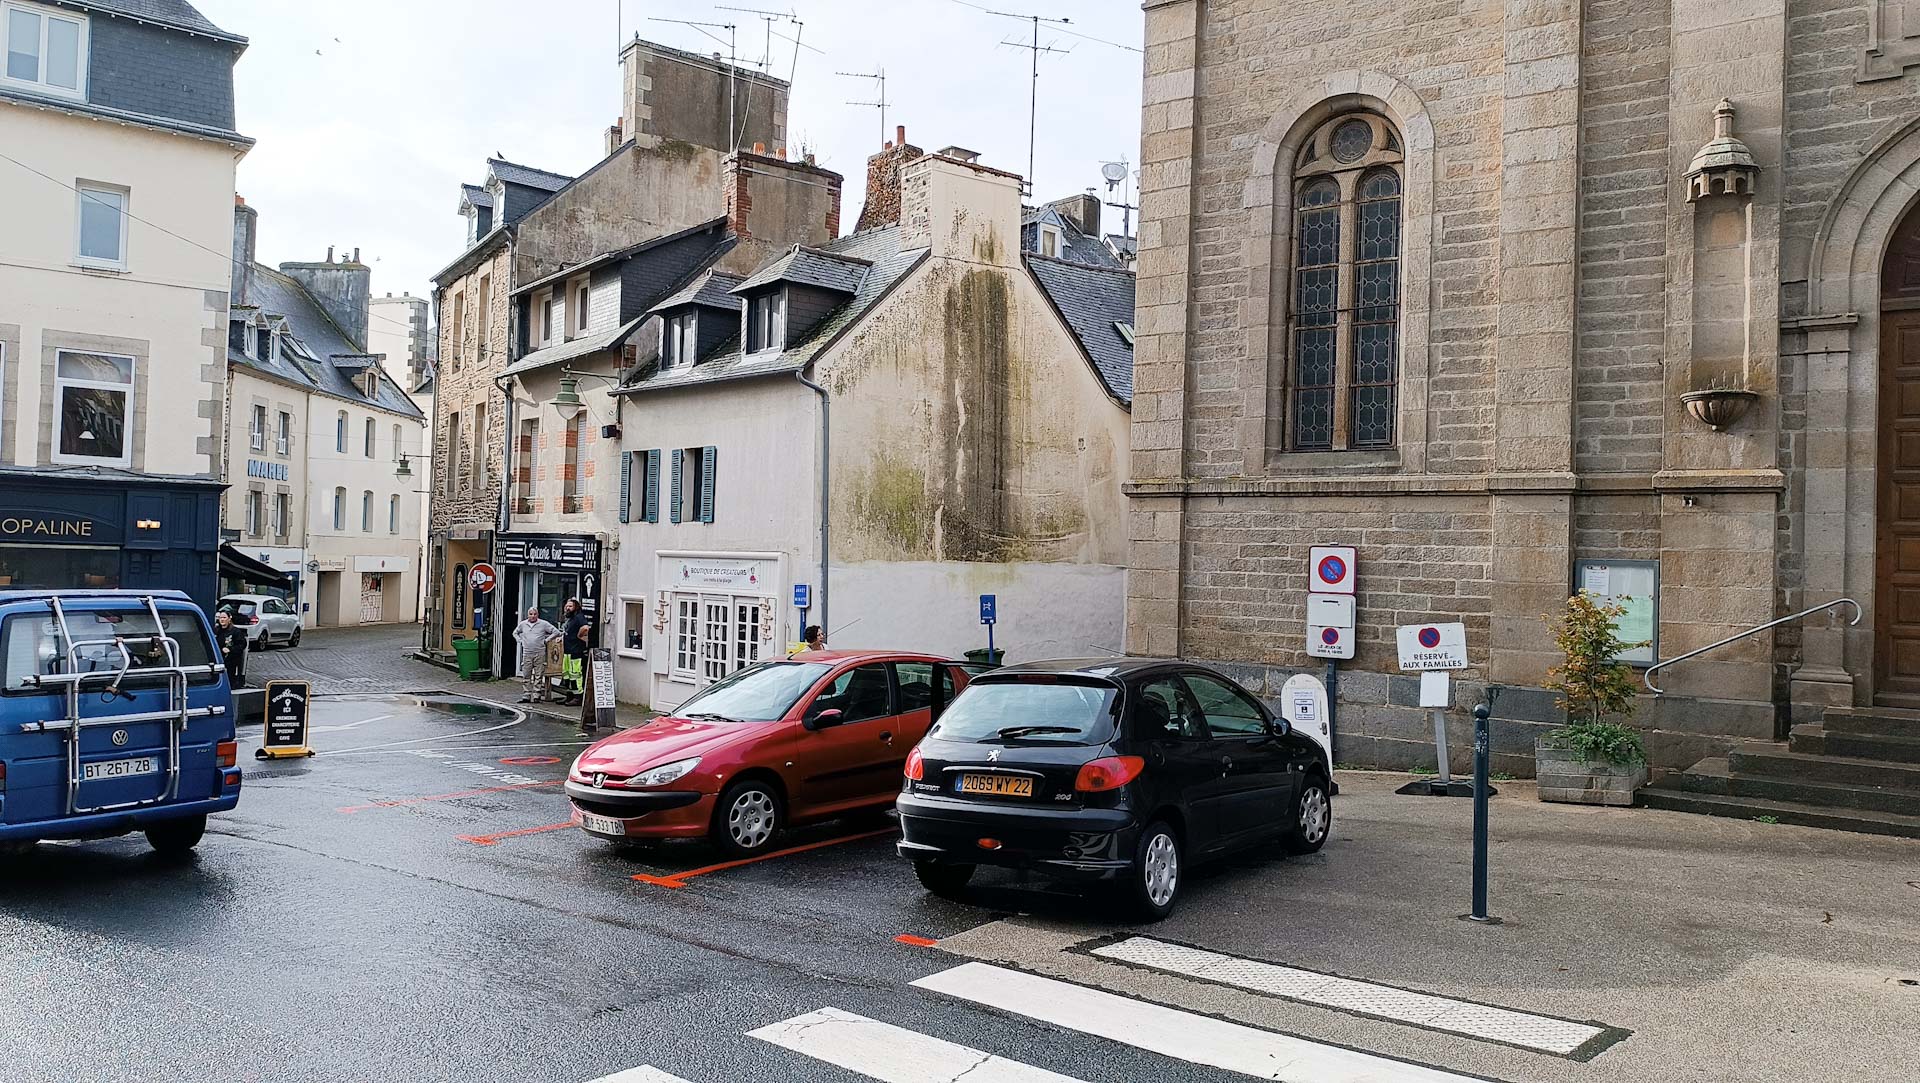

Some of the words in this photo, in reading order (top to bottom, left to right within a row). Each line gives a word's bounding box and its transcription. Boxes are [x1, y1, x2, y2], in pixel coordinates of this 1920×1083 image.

[1, 518, 92, 536] OPALINE
[691, 567, 713, 575] BOUTIQUE
[1403, 661, 1420, 669] AUX
[1423, 660, 1462, 668] FAMILLES
[964, 775, 993, 791] 2069
[996, 777, 1011, 792] WY
[1013, 778, 1030, 794] 22
